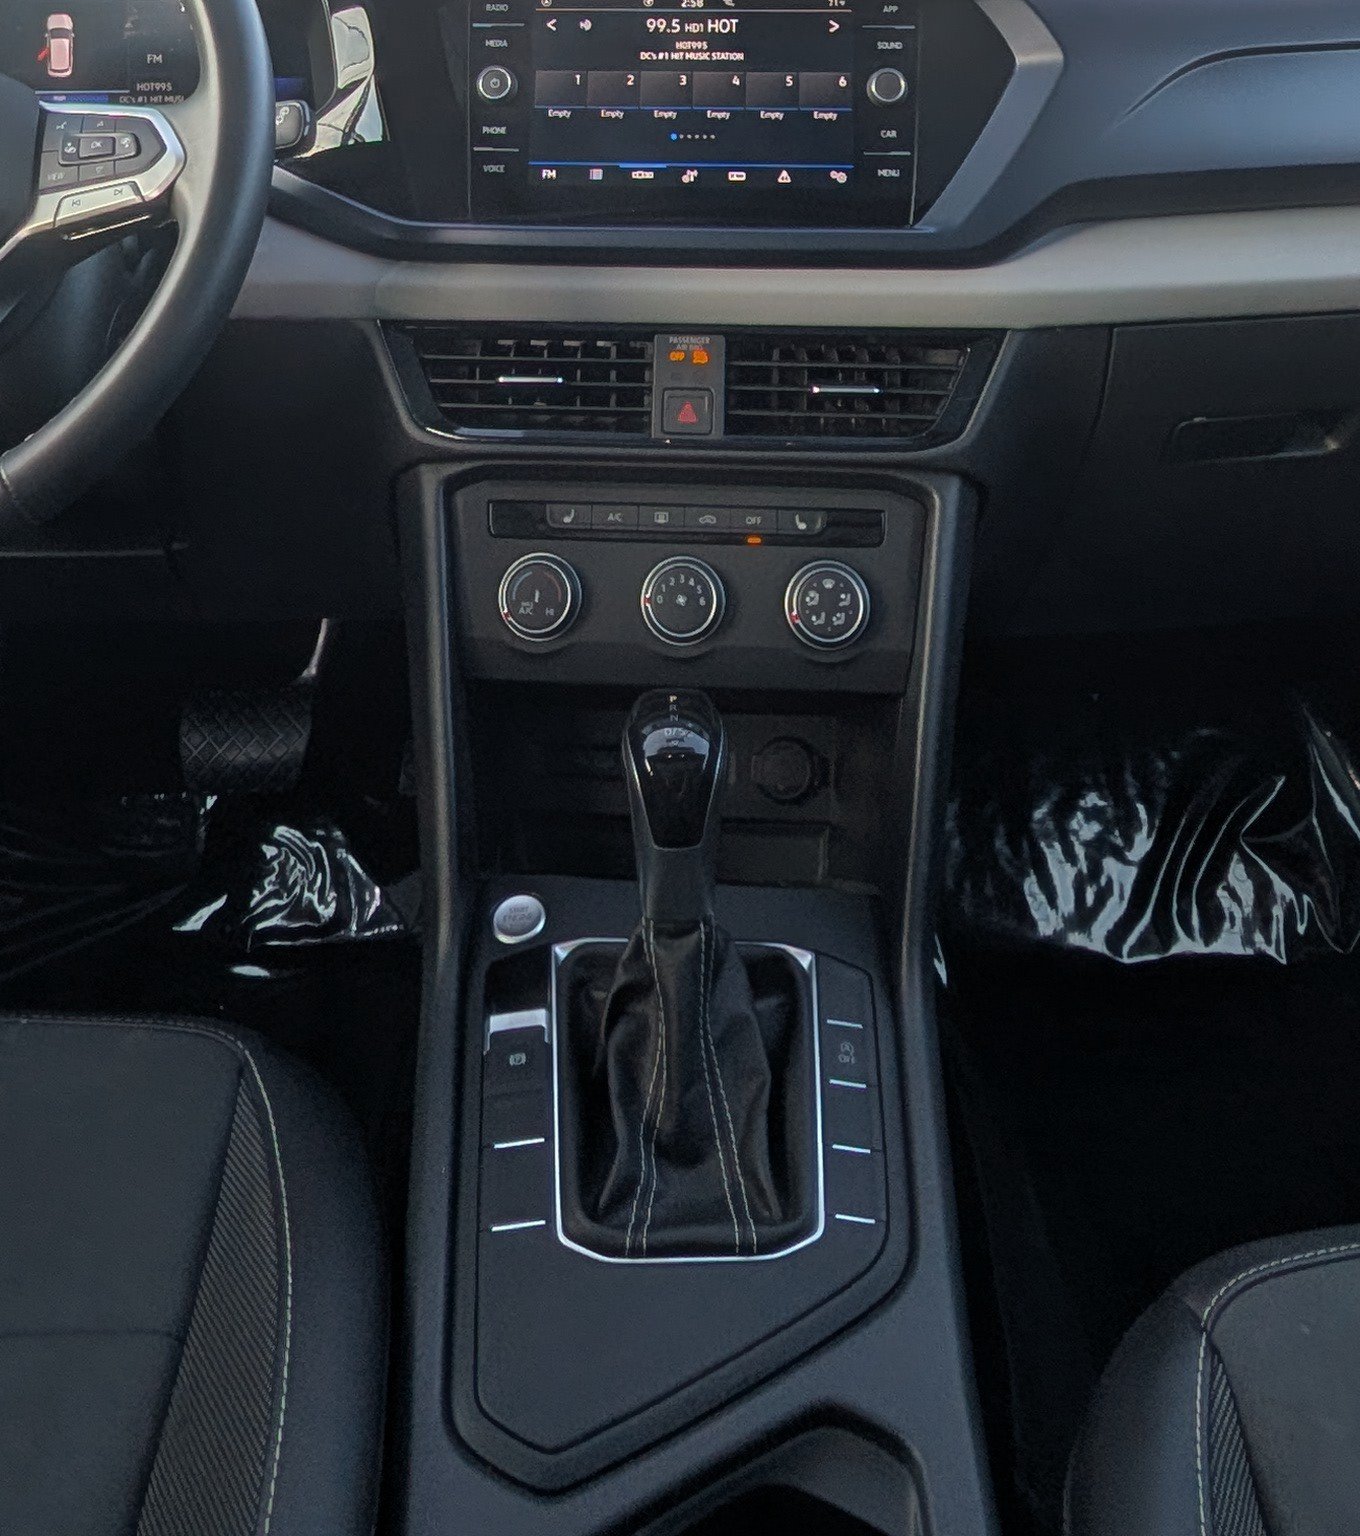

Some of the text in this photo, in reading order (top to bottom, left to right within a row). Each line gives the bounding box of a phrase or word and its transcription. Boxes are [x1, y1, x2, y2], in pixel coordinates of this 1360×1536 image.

[486, 4, 509, 12] RADIO
[883, 5, 899, 13] APP
[646, 18, 740, 34] 99.5 HD1 HOT
[485, 39, 508, 48] MEDIA
[877, 41, 903, 50] SOUND
[146, 53, 163, 64] FM
[640, 52, 658, 61] DC's
[670, 52, 684, 61] HIT
[685, 52, 711, 61] MUSIC
[711, 52, 745, 61] STATION
[574, 73, 581, 85] 1
[626, 74, 635, 86] 2
[679, 74, 687, 86] 3
[732, 75, 740, 86] 4
[785, 75, 793, 87] 5
[838, 75, 847, 87] 6
[548, 109, 572, 118] Empty
[601, 109, 625, 119] Empty
[654, 110, 678, 119] Empty
[707, 110, 731, 120] Empty
[760, 111, 784, 120] Empty
[813, 111, 838, 121] Empty
[482, 126, 507, 134] PHONE
[880, 130, 897, 138] CAR
[91, 141, 103, 149] OK
[483, 164, 505, 173] VOICE
[877, 168, 900, 177] MENU
[541, 169, 557, 180] FM
[669, 336, 711, 344] PASSENGER
[607, 512, 623, 523] A/C
[745, 515, 763, 525] OFF
[669, 695, 678, 703] P
[669, 704, 678, 712] R
[670, 714, 679, 722] N
